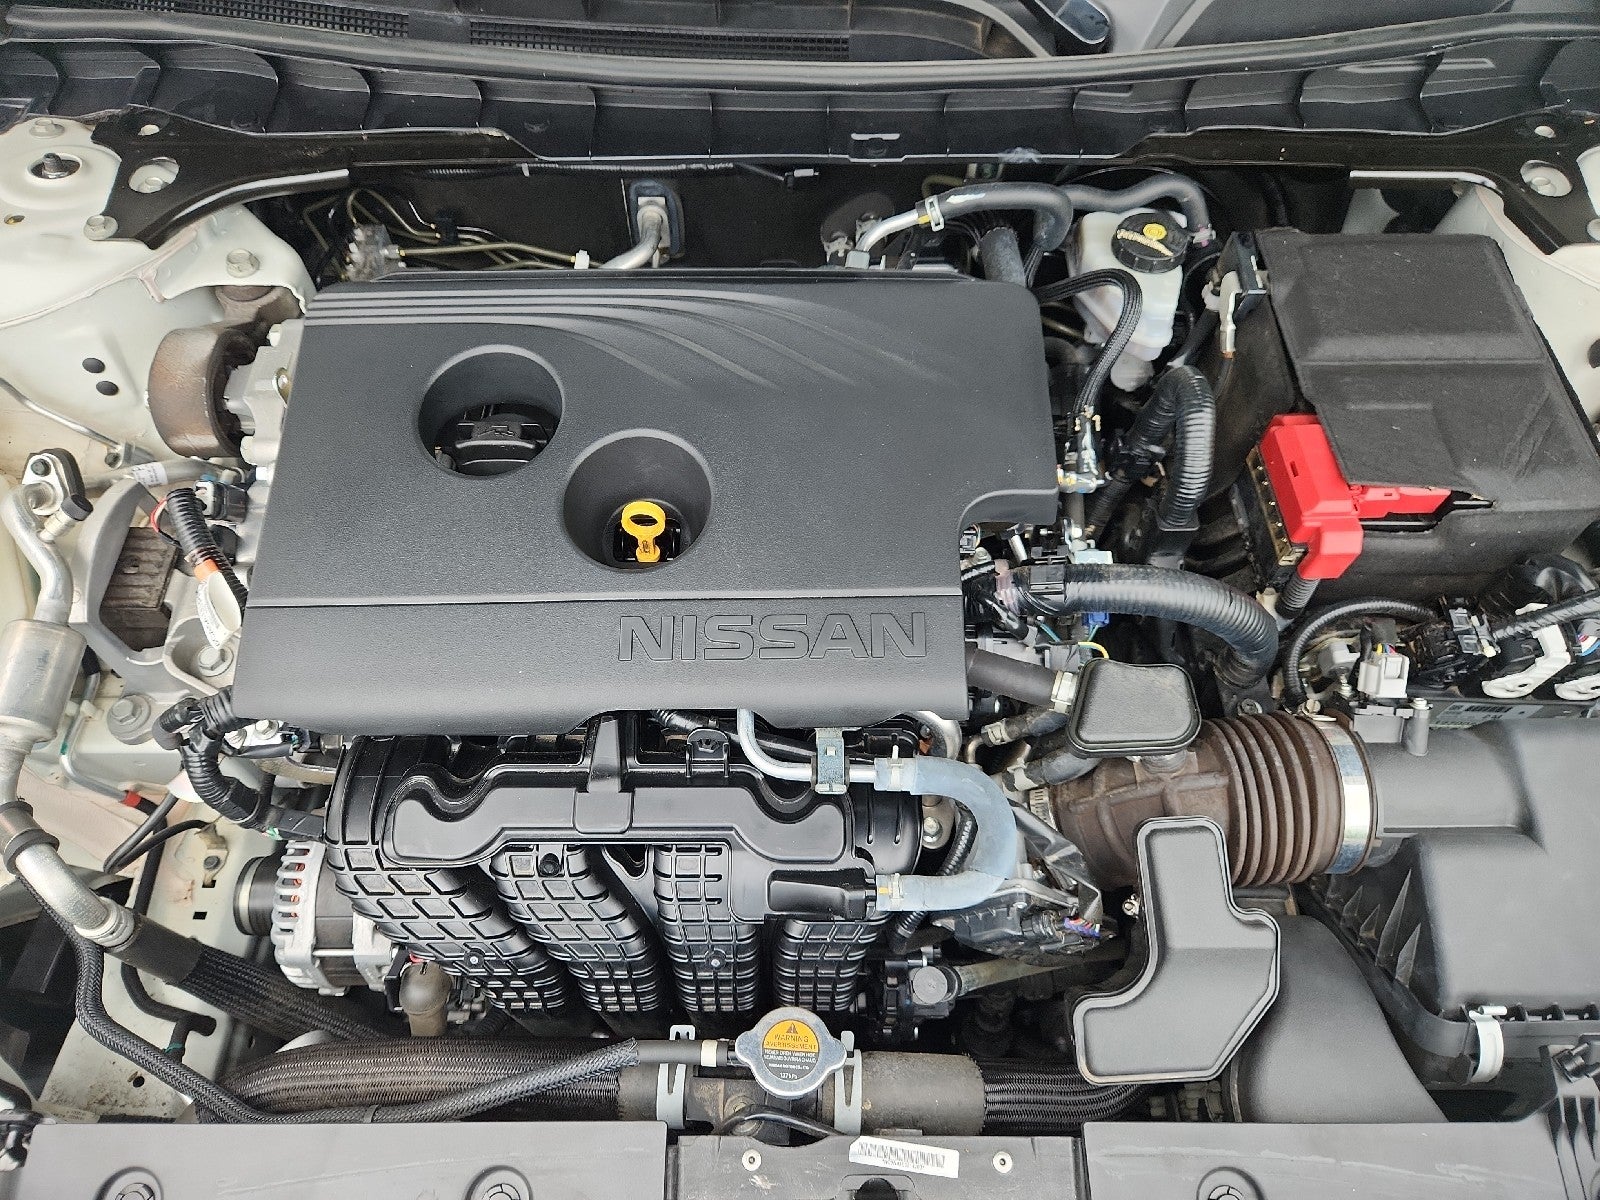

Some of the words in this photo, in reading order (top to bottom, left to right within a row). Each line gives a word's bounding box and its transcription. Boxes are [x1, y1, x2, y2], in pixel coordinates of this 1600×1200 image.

[618, 611, 927, 661] NISSAN
[774, 1034, 809, 1043] WARNING
[765, 1041, 816, 1050] AVERTISSEMENT
